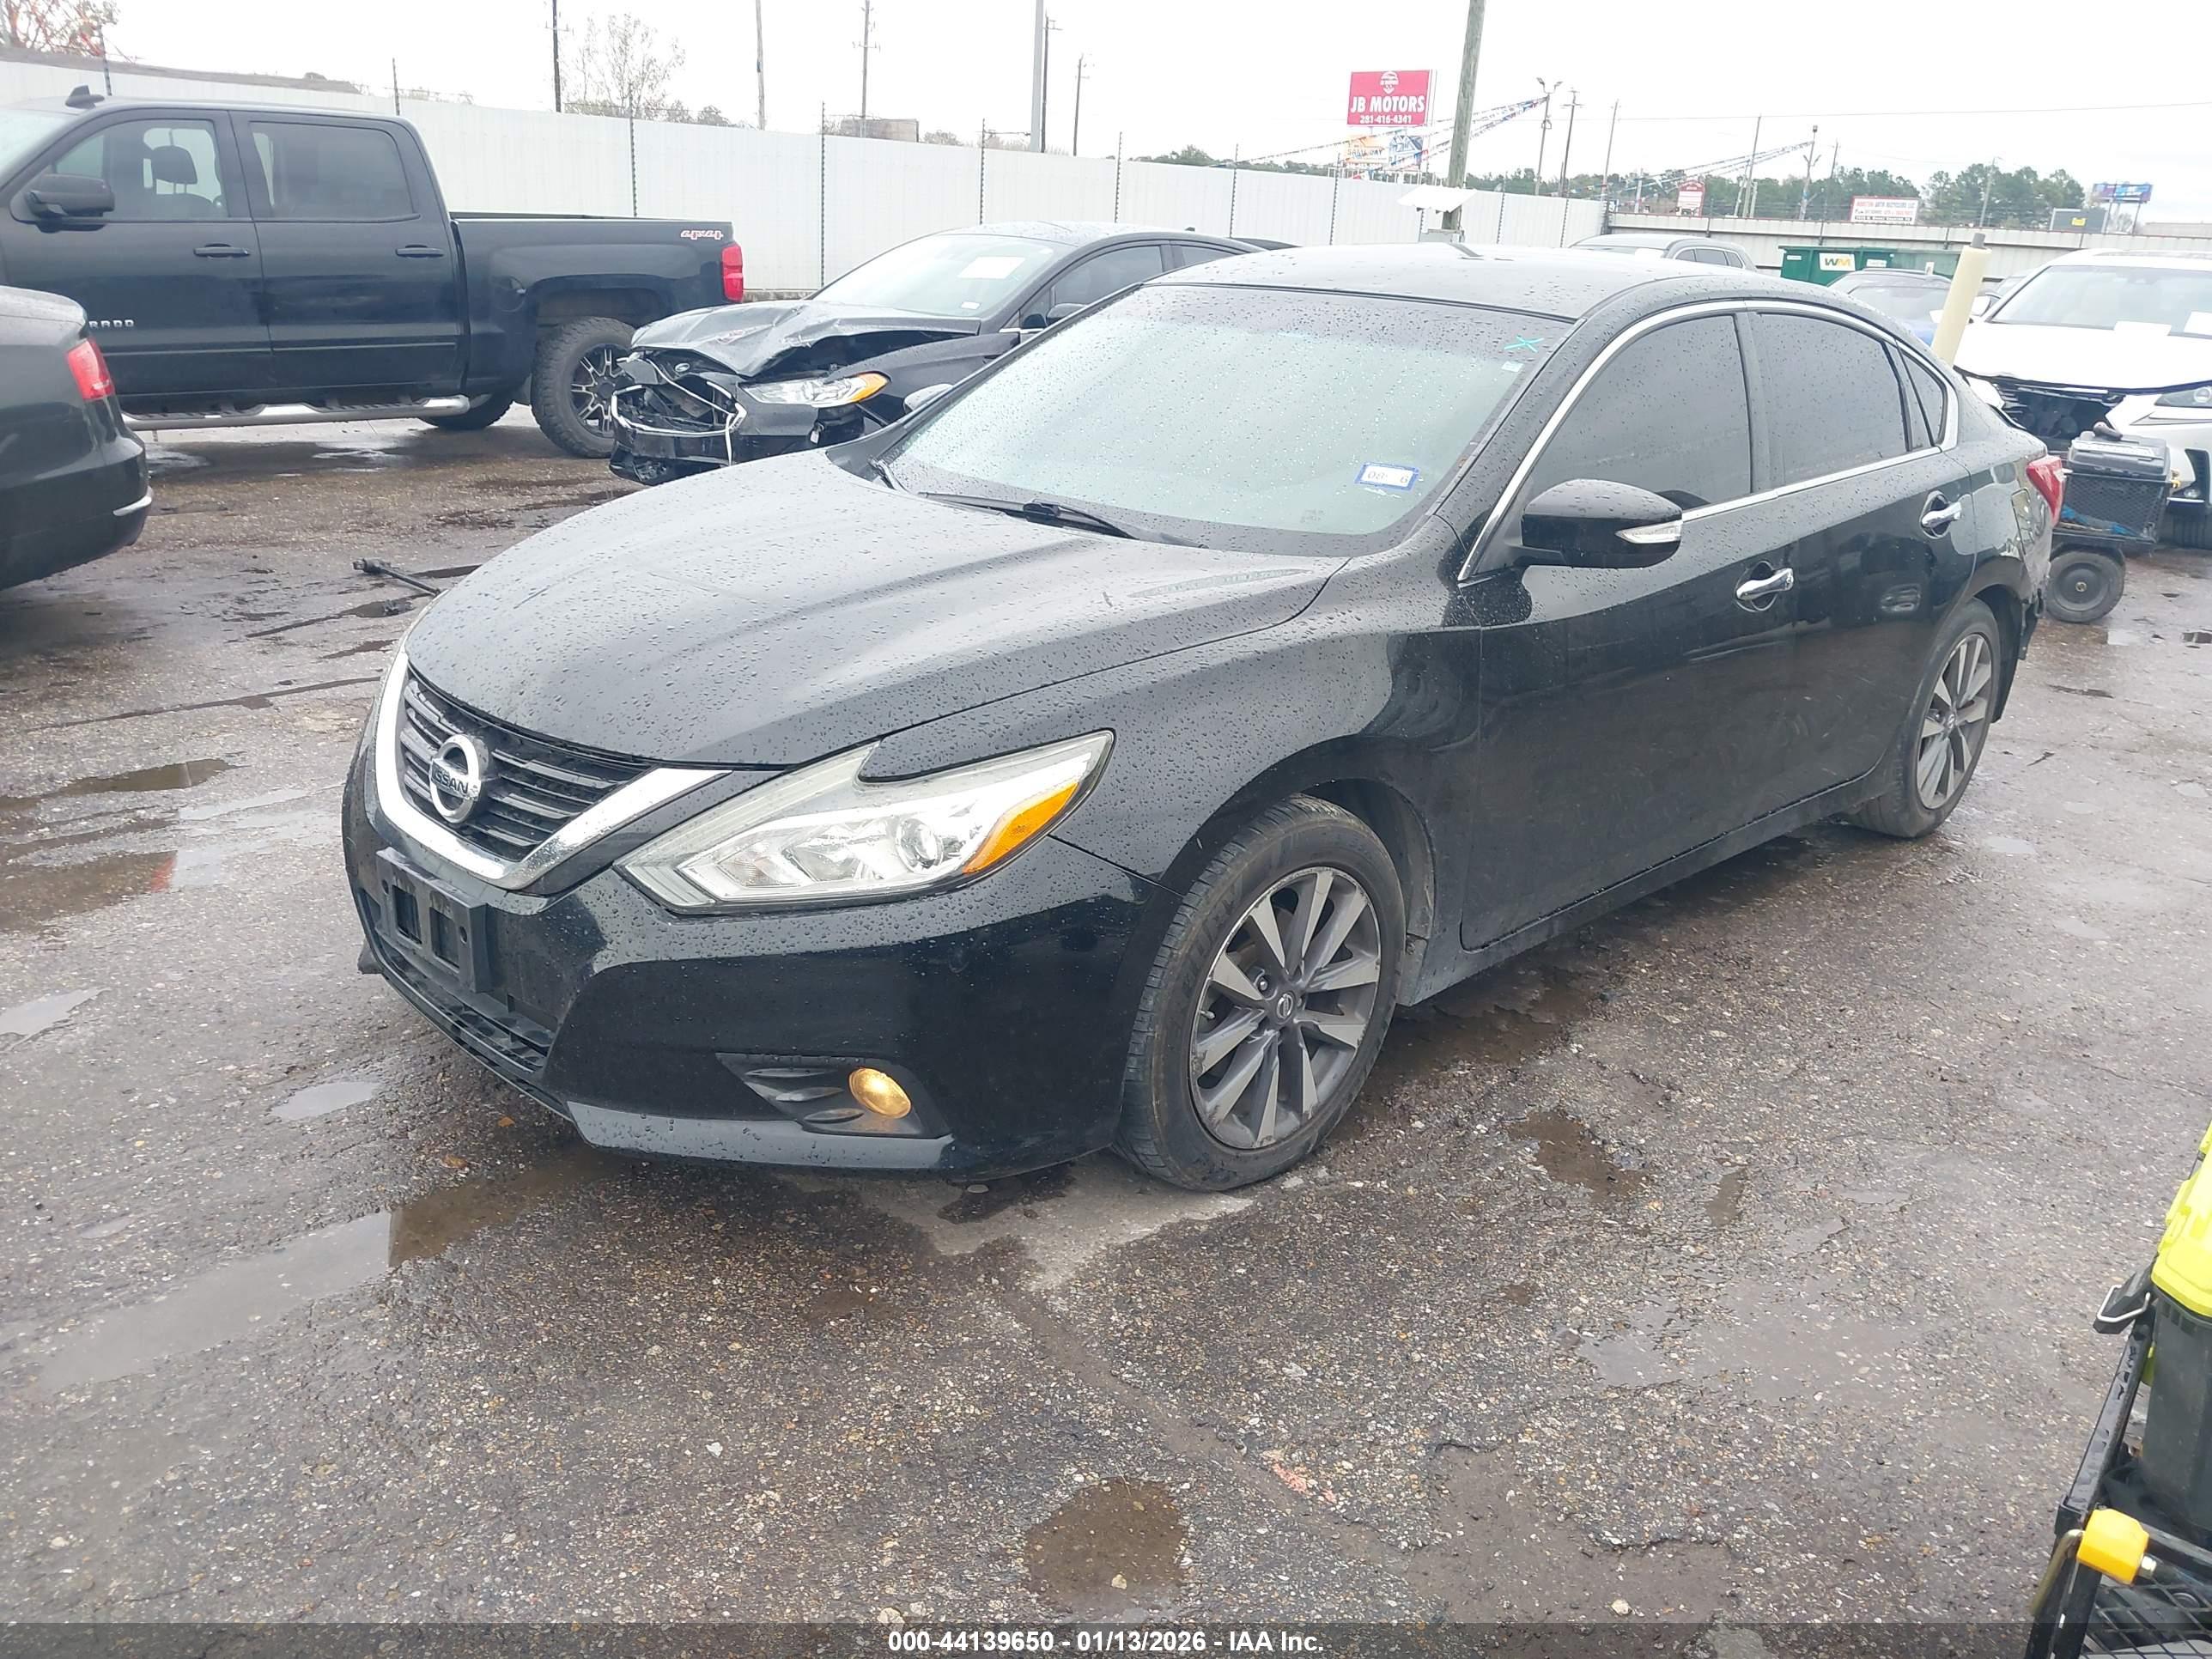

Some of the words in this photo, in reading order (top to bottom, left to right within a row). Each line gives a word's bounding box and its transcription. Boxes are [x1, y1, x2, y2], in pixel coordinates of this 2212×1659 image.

[1350, 96, 1366, 112] JB
[1370, 95, 1425, 112] MOTORS
[1825, 258, 1850, 266] WM
[88, 319, 135, 328] RADO
